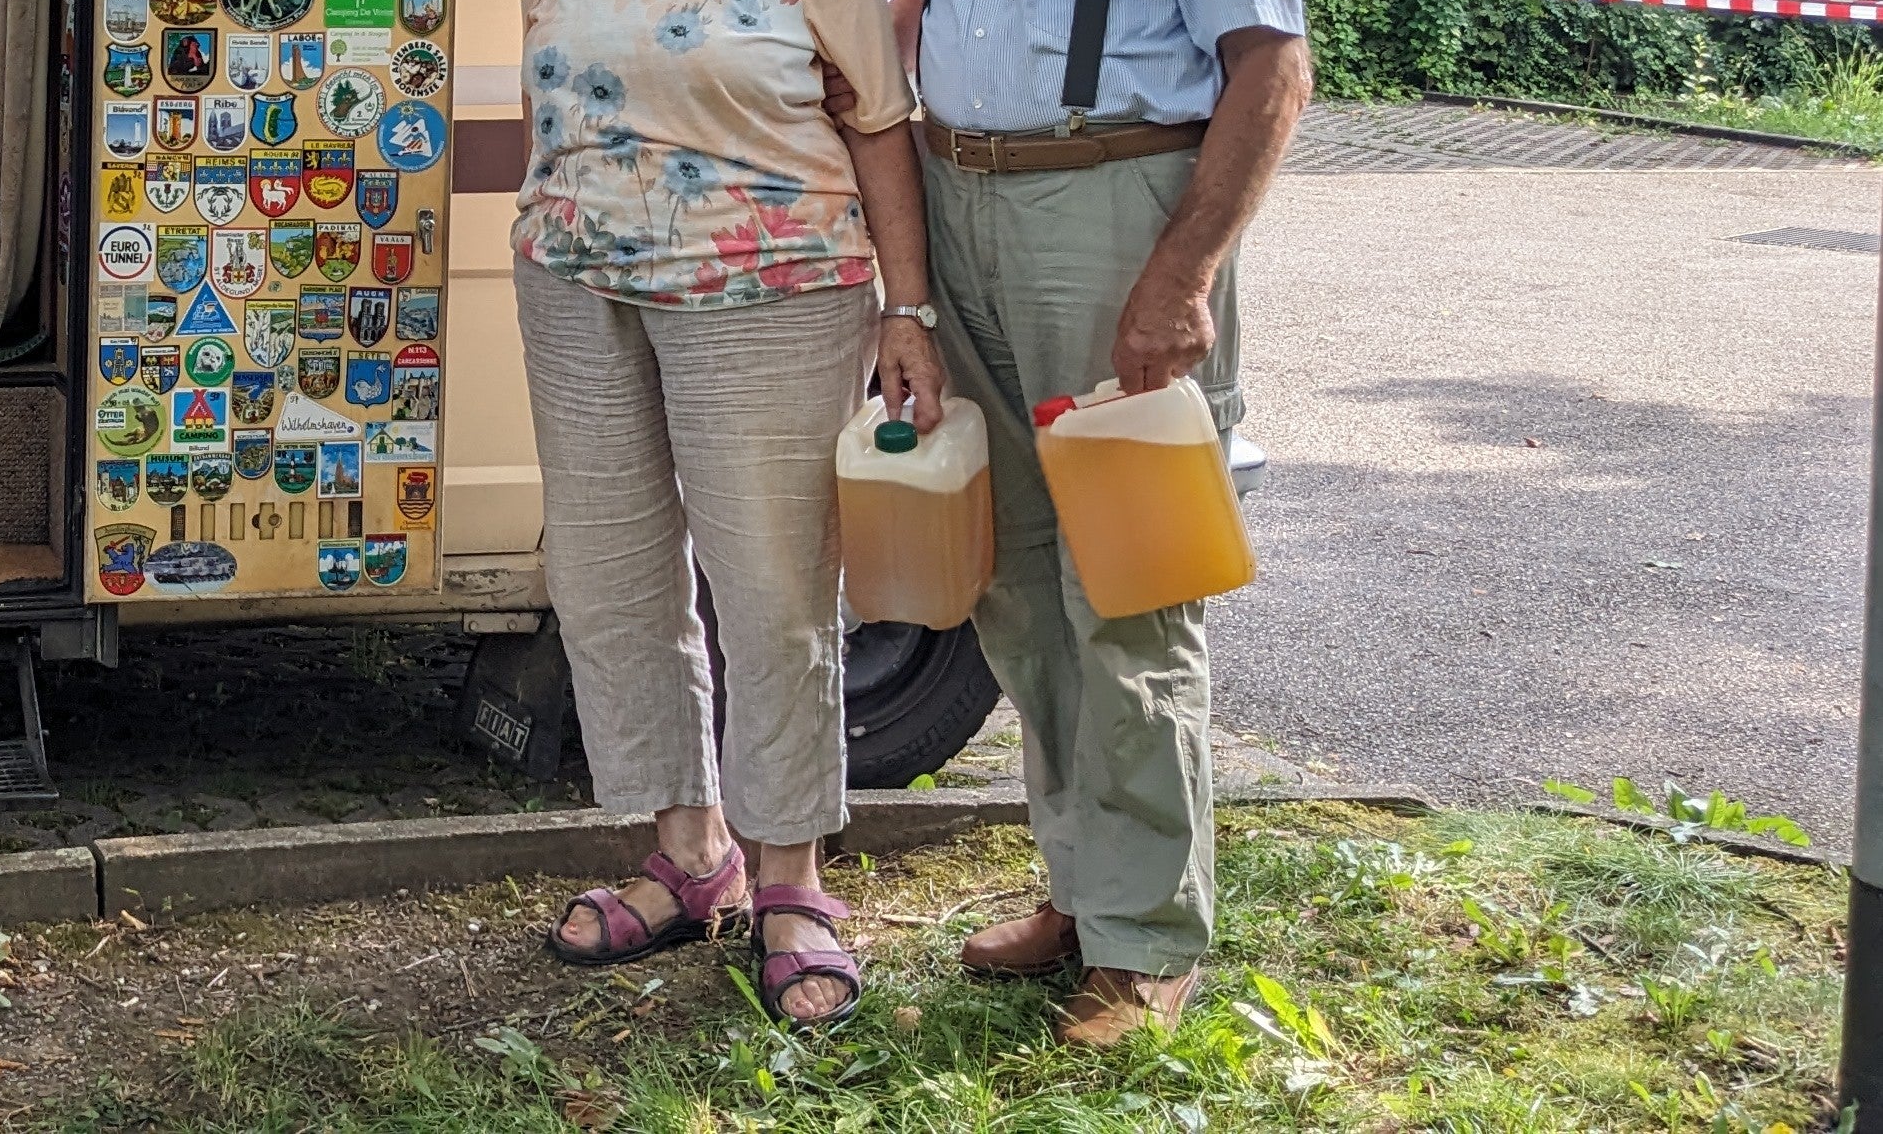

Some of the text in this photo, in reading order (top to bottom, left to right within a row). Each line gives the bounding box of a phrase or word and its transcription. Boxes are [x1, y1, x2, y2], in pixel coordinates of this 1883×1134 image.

[326, 8, 358, 17] Camping
[287, 34, 316, 42] LABOE
[392, 41, 433, 74] AFFENBERG
[433, 45, 447, 81] SALEM
[394, 77, 440, 97] BODENSEE
[213, 99, 237, 108] Ribe
[111, 241, 140, 252] EURO
[104, 253, 145, 264] TUNNEL
[397, 357, 437, 365] CARCASSONNE
[281, 417, 348, 432] Wilhelmshaven
[179, 432, 219, 440] CAMPING
[151, 455, 185, 463] HUSUM
[479, 706, 528, 748] FIAT
